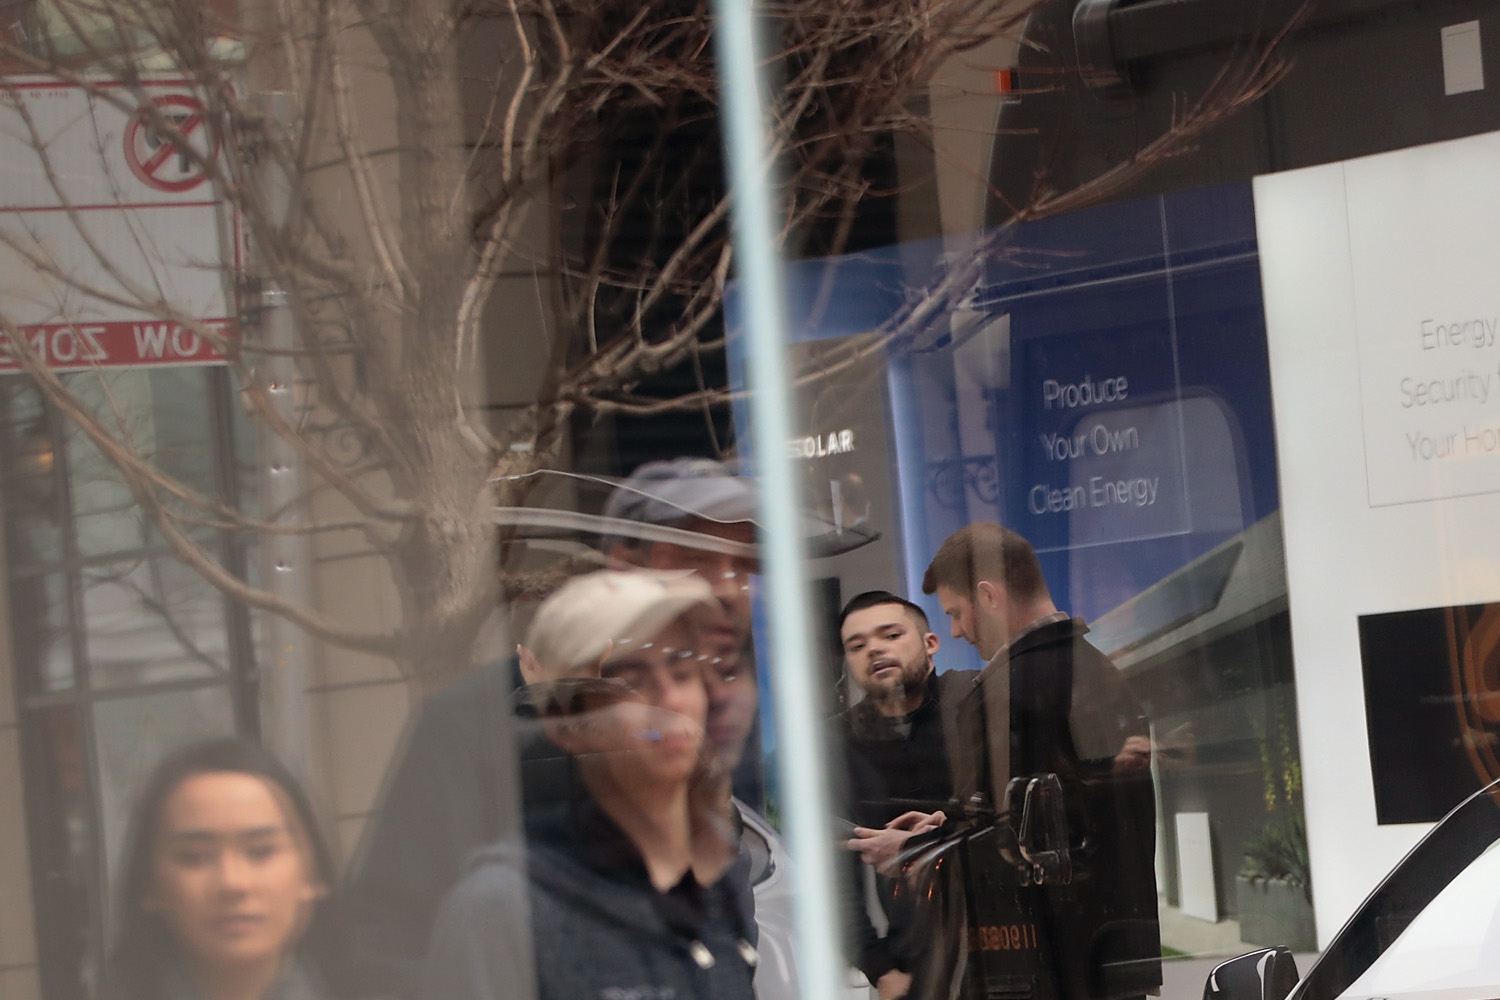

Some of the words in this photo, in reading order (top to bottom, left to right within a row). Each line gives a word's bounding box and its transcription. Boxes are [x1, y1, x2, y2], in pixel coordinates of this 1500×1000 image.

[1420, 317, 1498, 350] Energy
[1042, 374, 1129, 409] Produce
[1400, 368, 1490, 408] Security
[1039, 432, 1088, 461] Your
[1090, 424, 1140, 455] Own
[1405, 430, 1458, 461] Your
[1027, 483, 1087, 515] Clean
[1089, 475, 1160, 507] Energy
